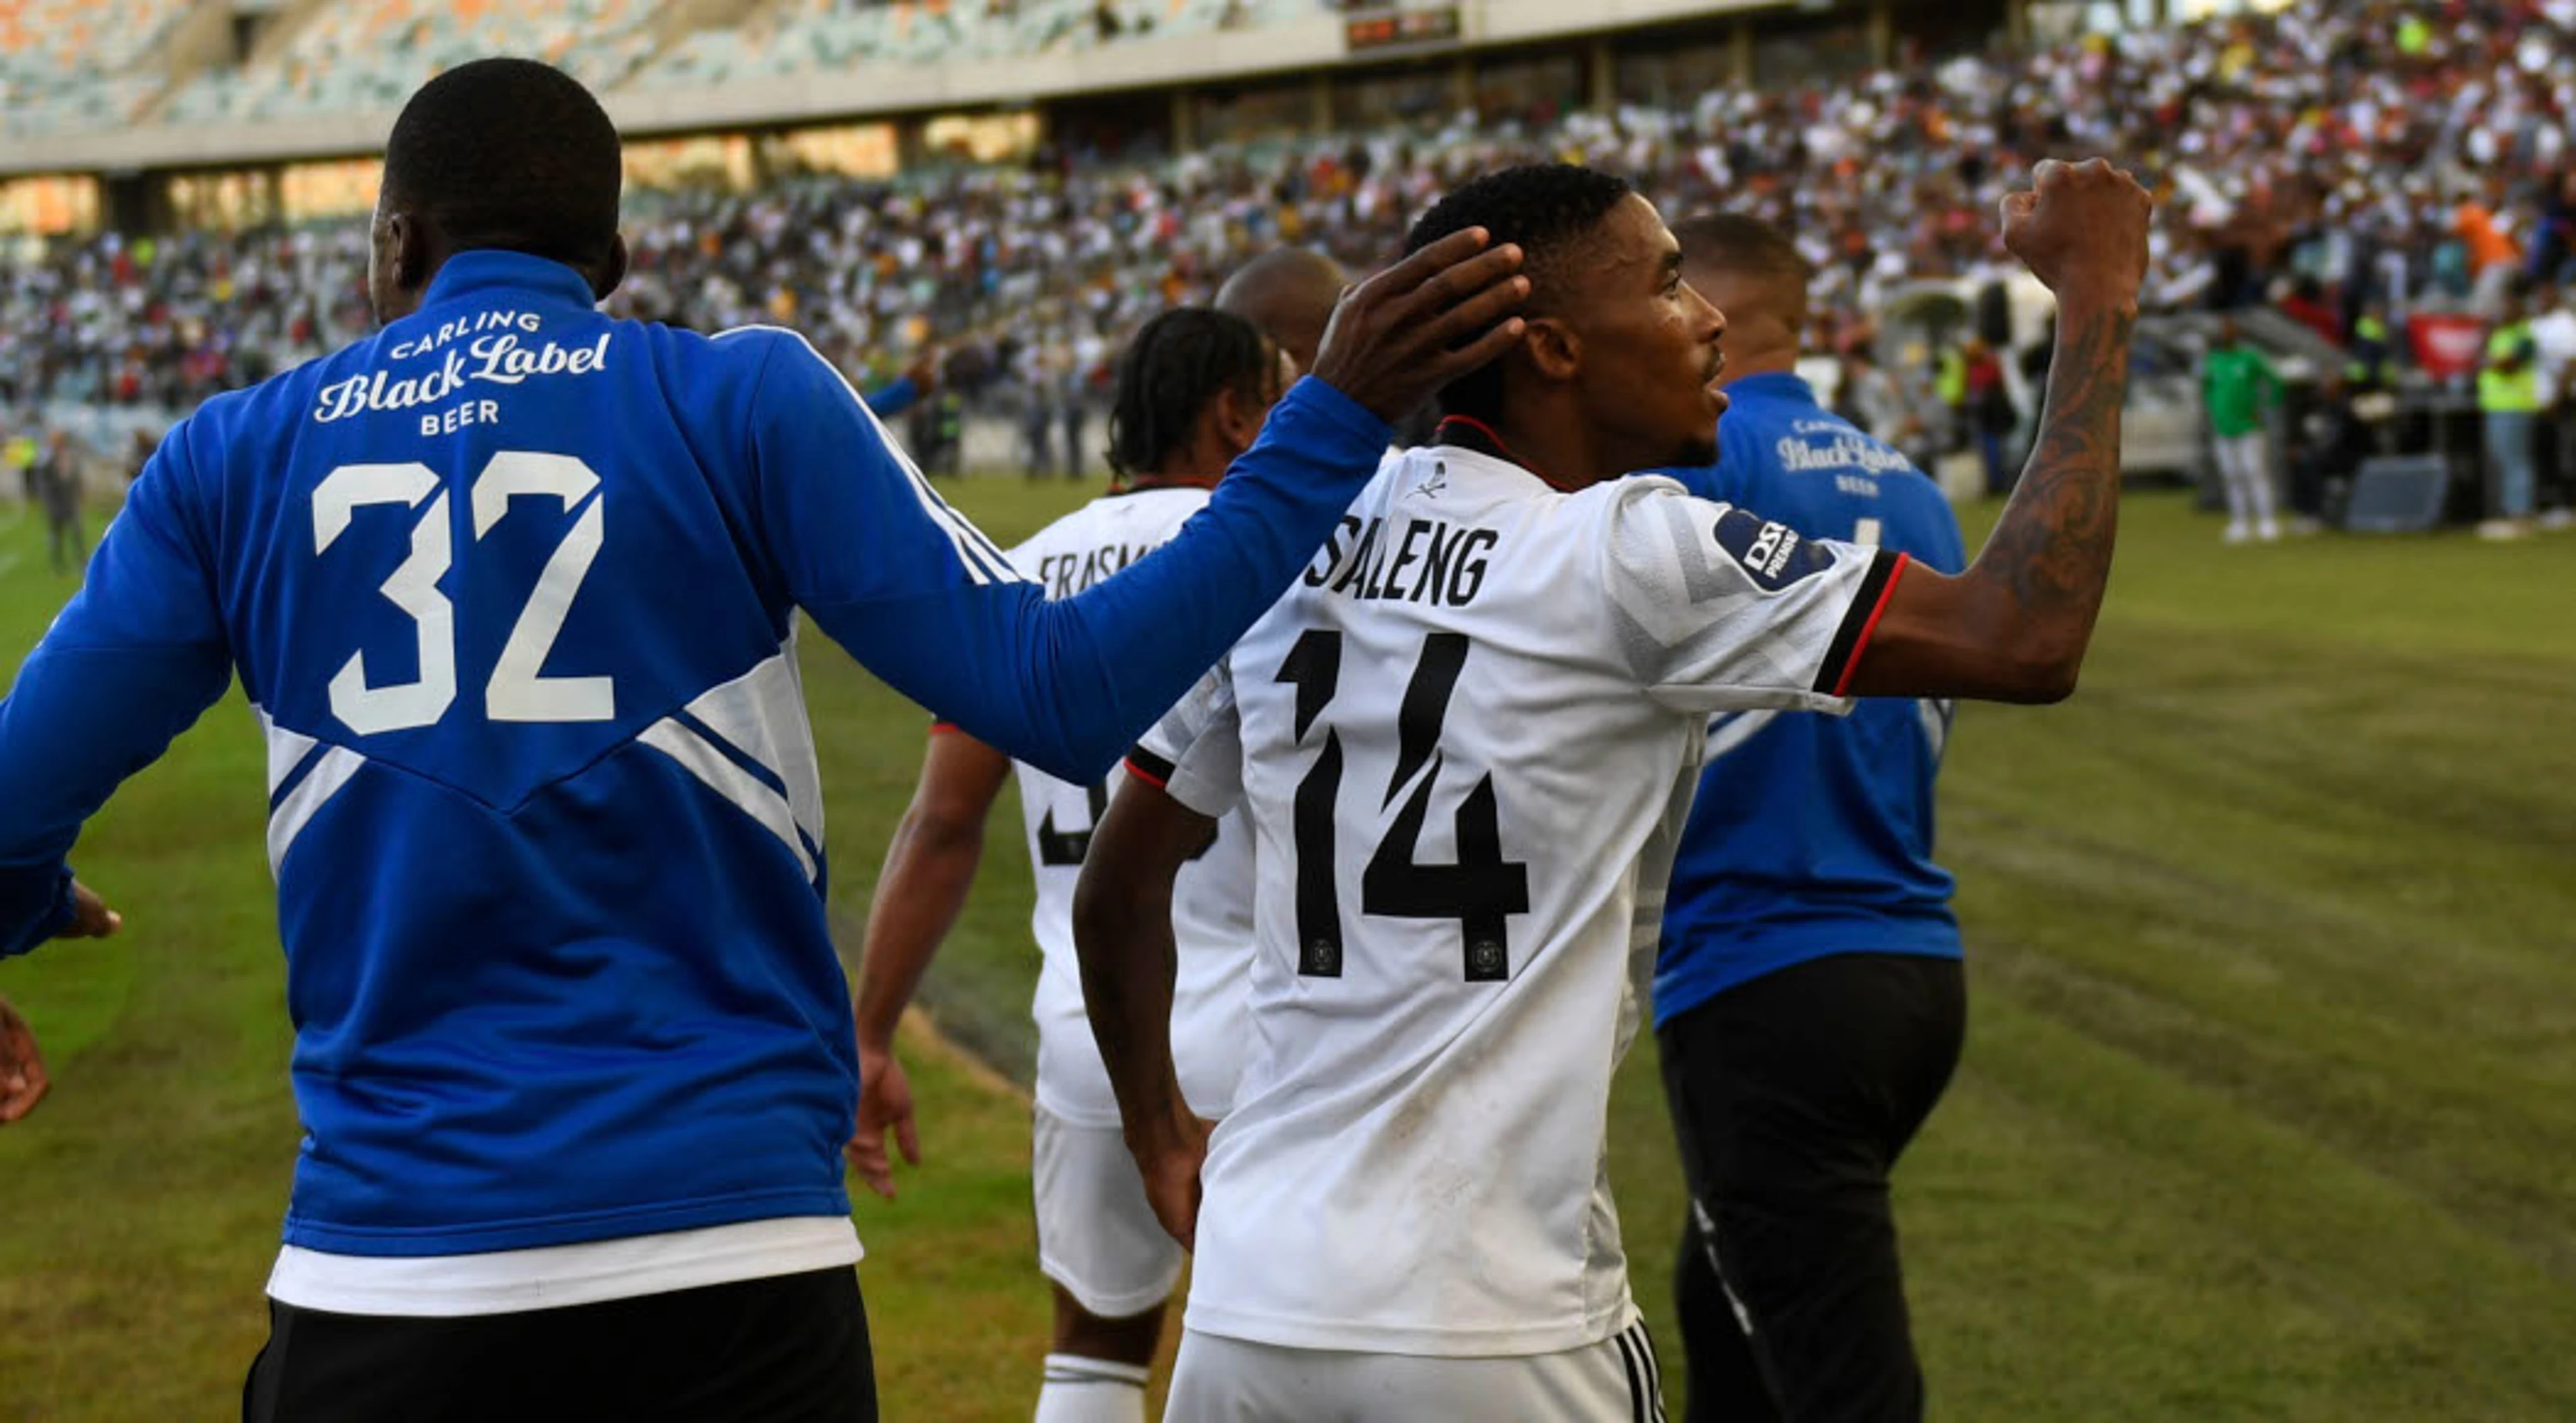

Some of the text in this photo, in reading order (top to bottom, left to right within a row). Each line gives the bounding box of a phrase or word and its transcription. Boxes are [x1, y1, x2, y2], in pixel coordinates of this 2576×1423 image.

[313, 333, 612, 423] Black Label
[390, 310, 541, 360] CARLING
[420, 399, 499, 437] BEER
[311, 450, 615, 737] 32
[1039, 543, 1157, 600] ERASM
[1304, 515, 1499, 607] SALENG
[1274, 629, 1530, 982] 14
